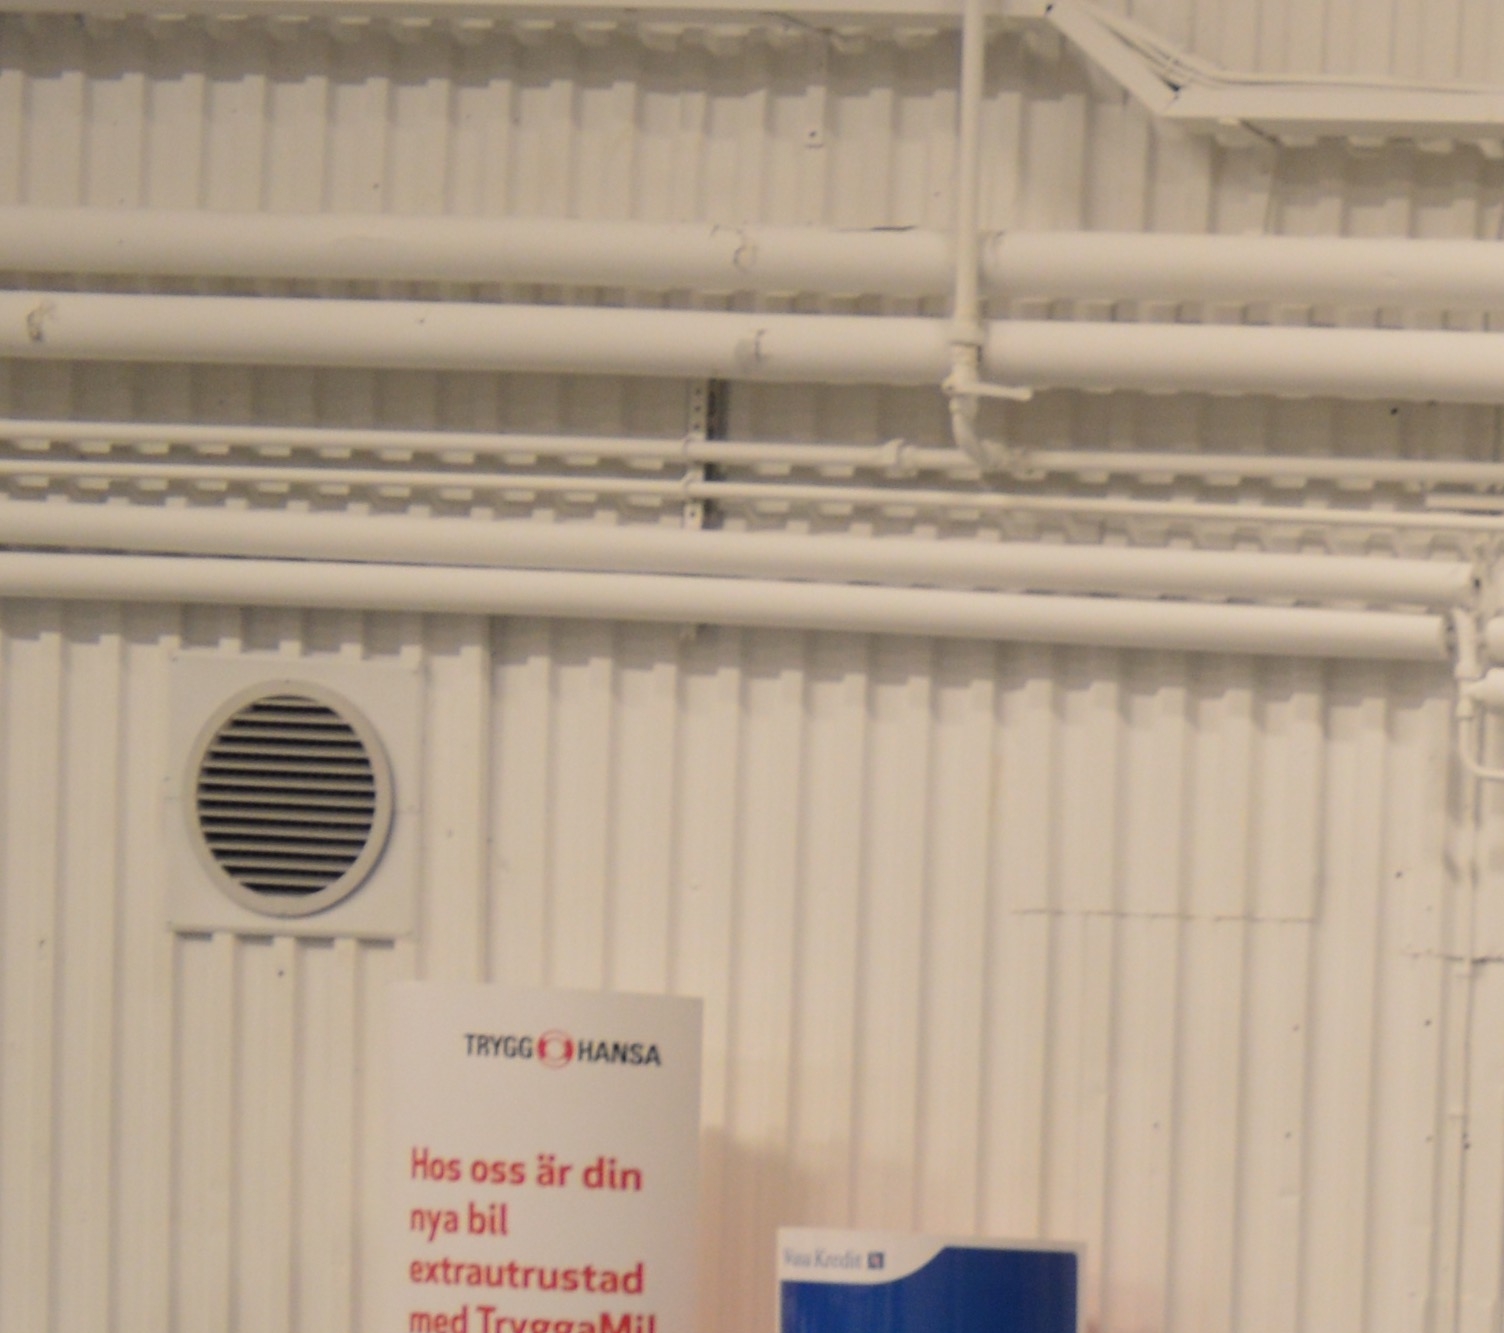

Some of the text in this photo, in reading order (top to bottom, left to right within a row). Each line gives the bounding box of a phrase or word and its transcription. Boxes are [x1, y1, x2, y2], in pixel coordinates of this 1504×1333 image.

[465, 1033, 661, 1067] TRYGG HANSA
[411, 1147, 643, 1191] Hos oss är din
[409, 1202, 508, 1242] nya bil
[409, 1258, 644, 1294] extrautrustad
